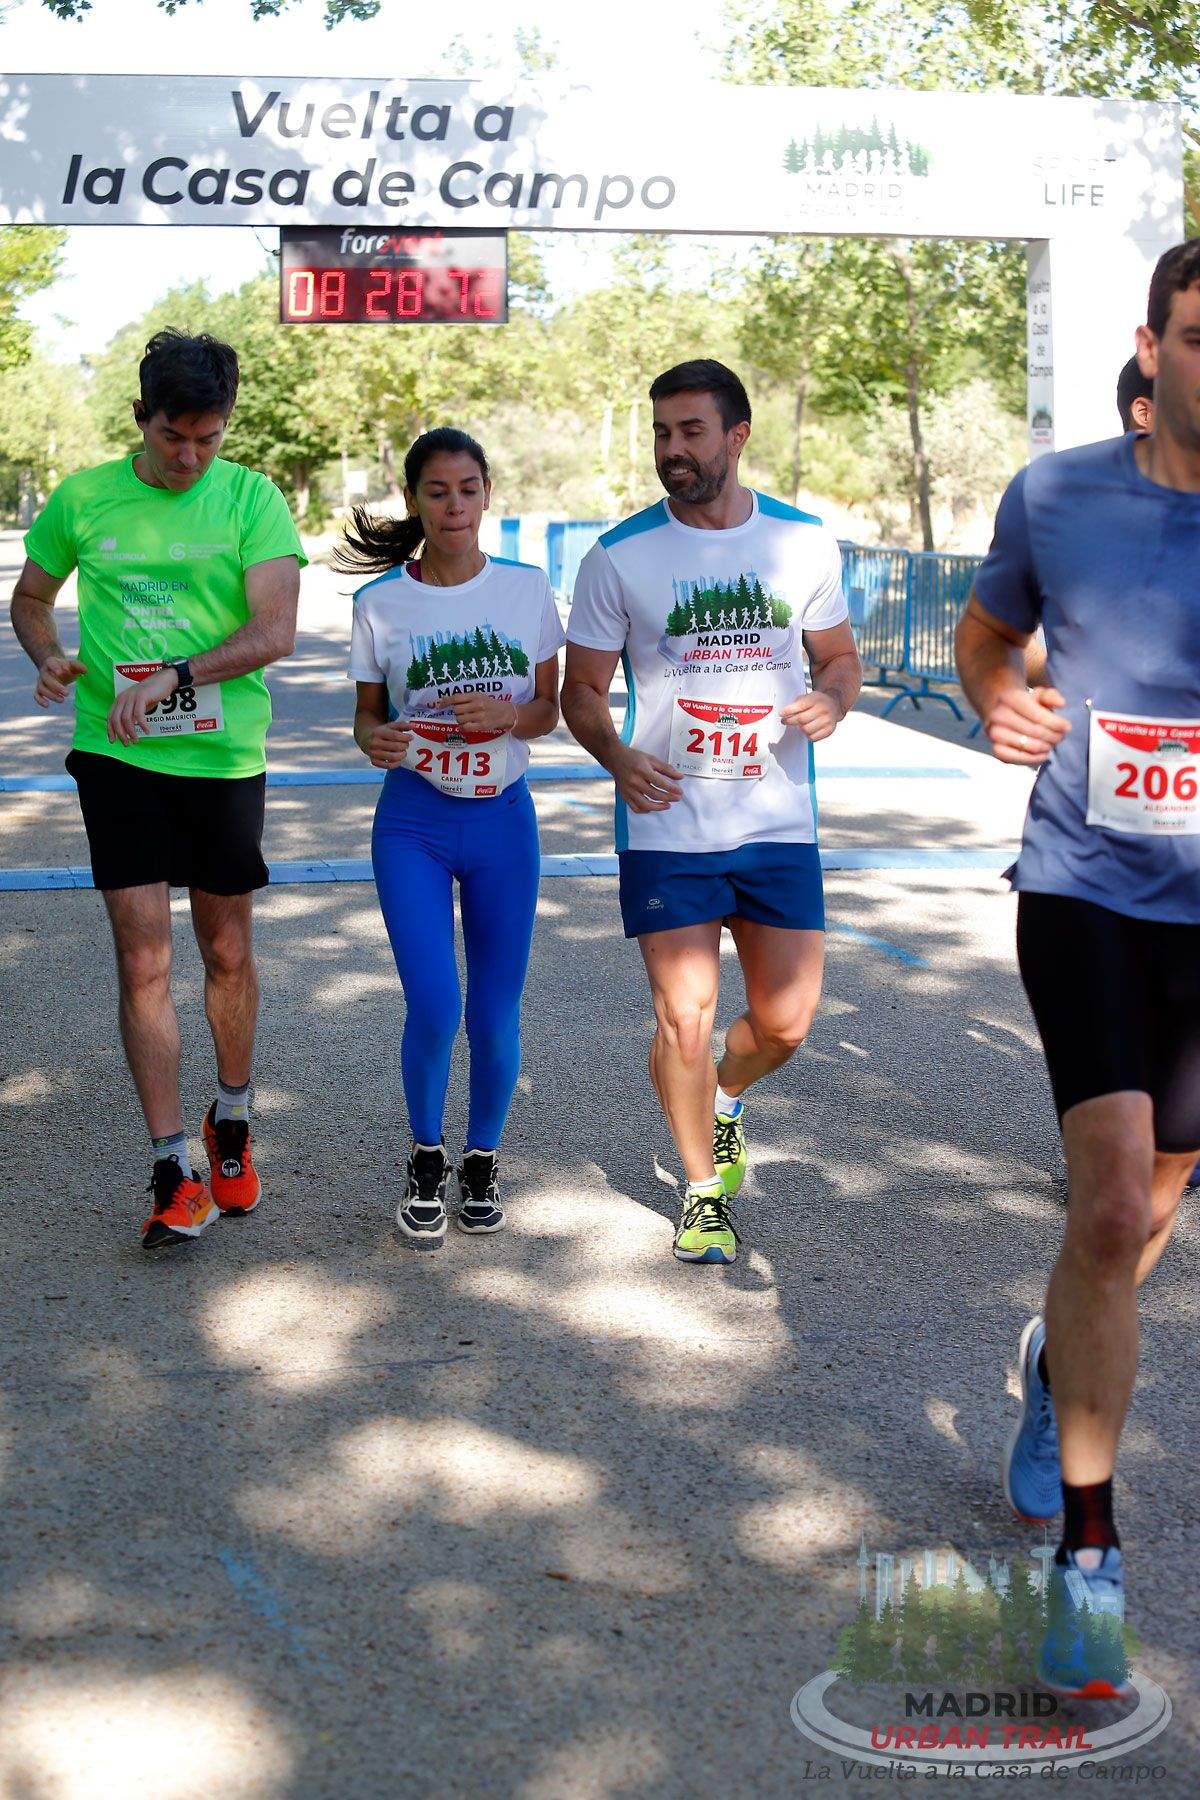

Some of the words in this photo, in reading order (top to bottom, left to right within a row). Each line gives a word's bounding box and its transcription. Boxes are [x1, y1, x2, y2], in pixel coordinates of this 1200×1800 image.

[231, 91, 451, 140] Vuelta
[474, 105, 514, 142] a
[62, 154, 125, 205] la
[142, 156, 310, 206] Casa
[332, 158, 415, 207] de
[439, 161, 676, 221] Campo
[806, 183, 902, 198] MADRID
[1044, 183, 1104, 206] LIFE
[365, 271, 423, 317] 28
[119, 581, 168, 592] MADRID
[172, 581, 189, 591] EN
[121, 594, 175, 605] MARCHA
[697, 633, 761, 647] MADRID
[683, 649, 732, 662] URBAN
[736, 647, 773, 659] TRAIL
[672, 664, 701, 676] Vuelta
[703, 666, 710, 674] a
[713, 664, 722, 674] la
[725, 663, 749, 673] Casa
[751, 662, 764, 671] de
[766, 661, 792, 671] Campo
[437, 681, 504, 699] MADRID
[692, 703, 712, 711] Vuelta
[166, 713, 197, 722] MAURICIO
[686, 728, 758, 757] 2114
[415, 748, 491, 777] 2113
